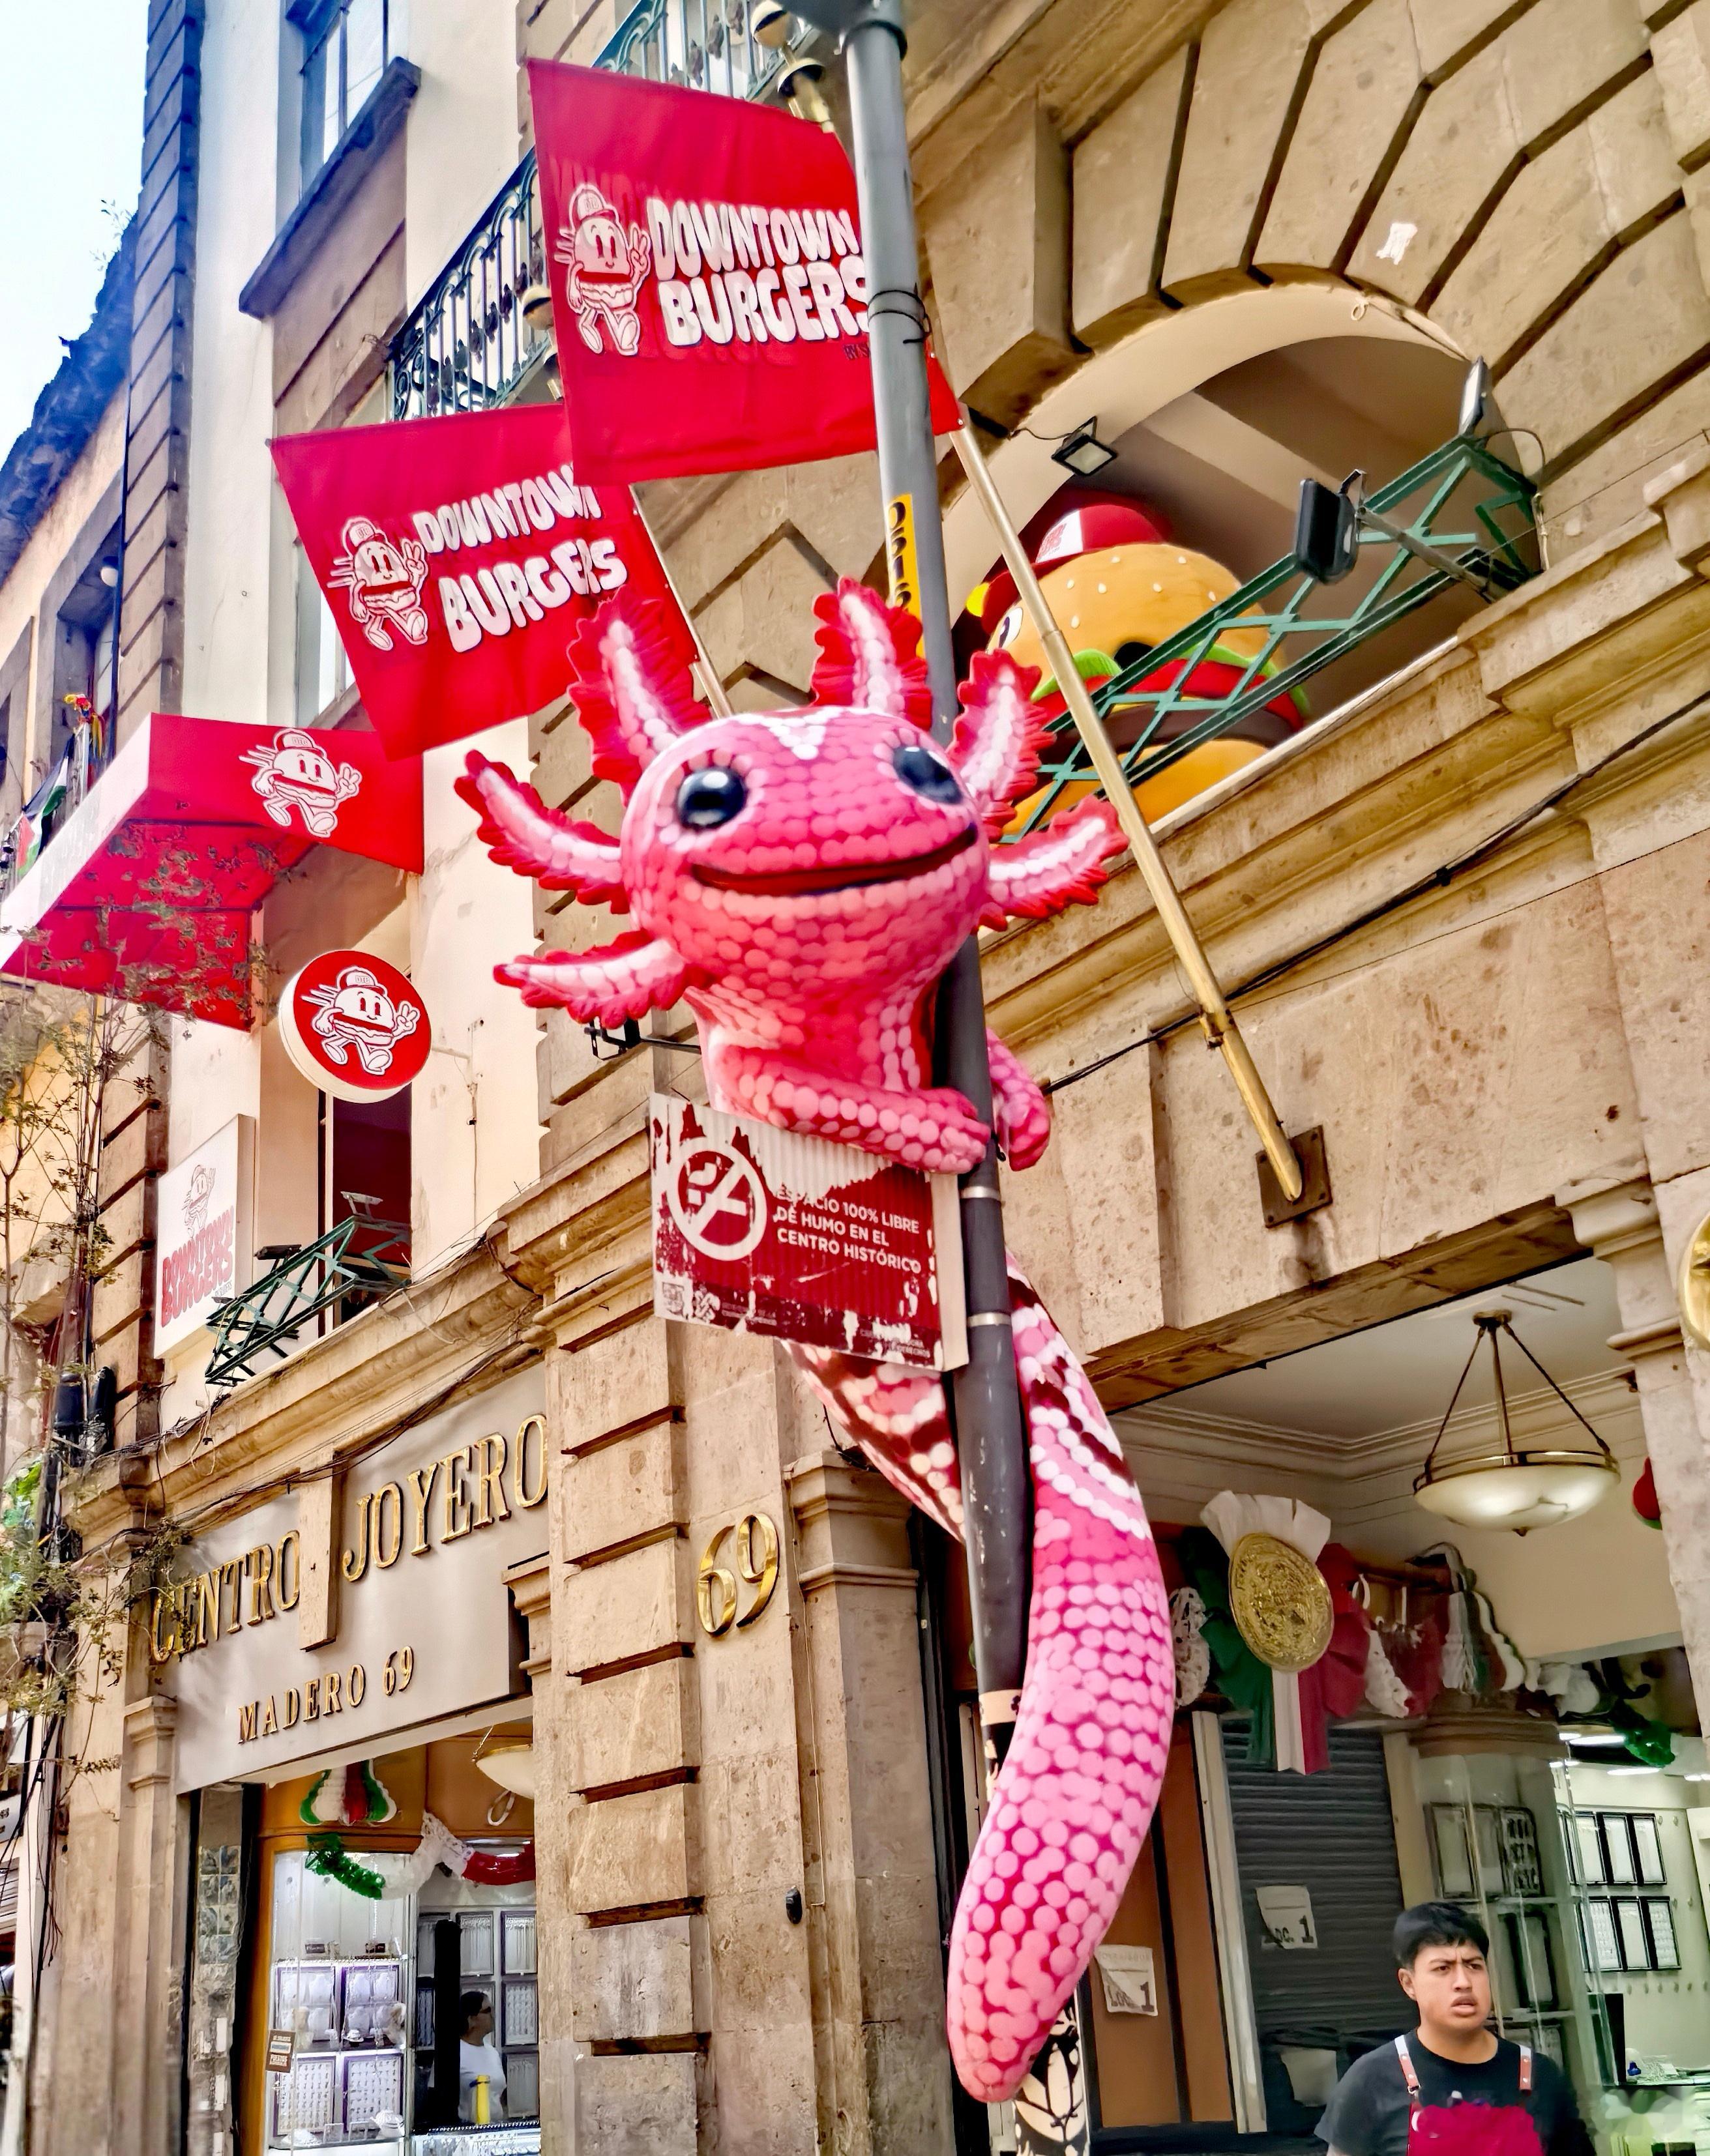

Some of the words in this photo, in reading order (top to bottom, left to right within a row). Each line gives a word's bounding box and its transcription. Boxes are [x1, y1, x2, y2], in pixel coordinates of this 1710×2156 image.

[646, 197, 860, 282] DOWNTOWN
[658, 255, 870, 346] BURGERS
[438, 537, 628, 653] BURGERS
[162, 1206, 234, 1294] DOWNTOWN
[776, 1206, 797, 1225] DE
[801, 1212, 846, 1236] HUMO
[849, 1223, 869, 1242] EN
[872, 1229, 890, 1247] EL
[776, 1228, 840, 1255] CENTRO
[843, 1242, 922, 1274] HISTÓRICO
[842, 1202, 879, 1223] 100%
[881, 1212, 920, 1234] LIBRE
[162, 1231, 233, 1328] BURGERS
[342, 1414, 549, 1582] JOYERO
[697, 1512, 780, 1638] 69
[238, 1663, 366, 1745] MADERO
[382, 1646, 415, 1697] 69
[1299, 1915, 1314, 1944] 1
[1140, 1981, 1155, 2013] 1
